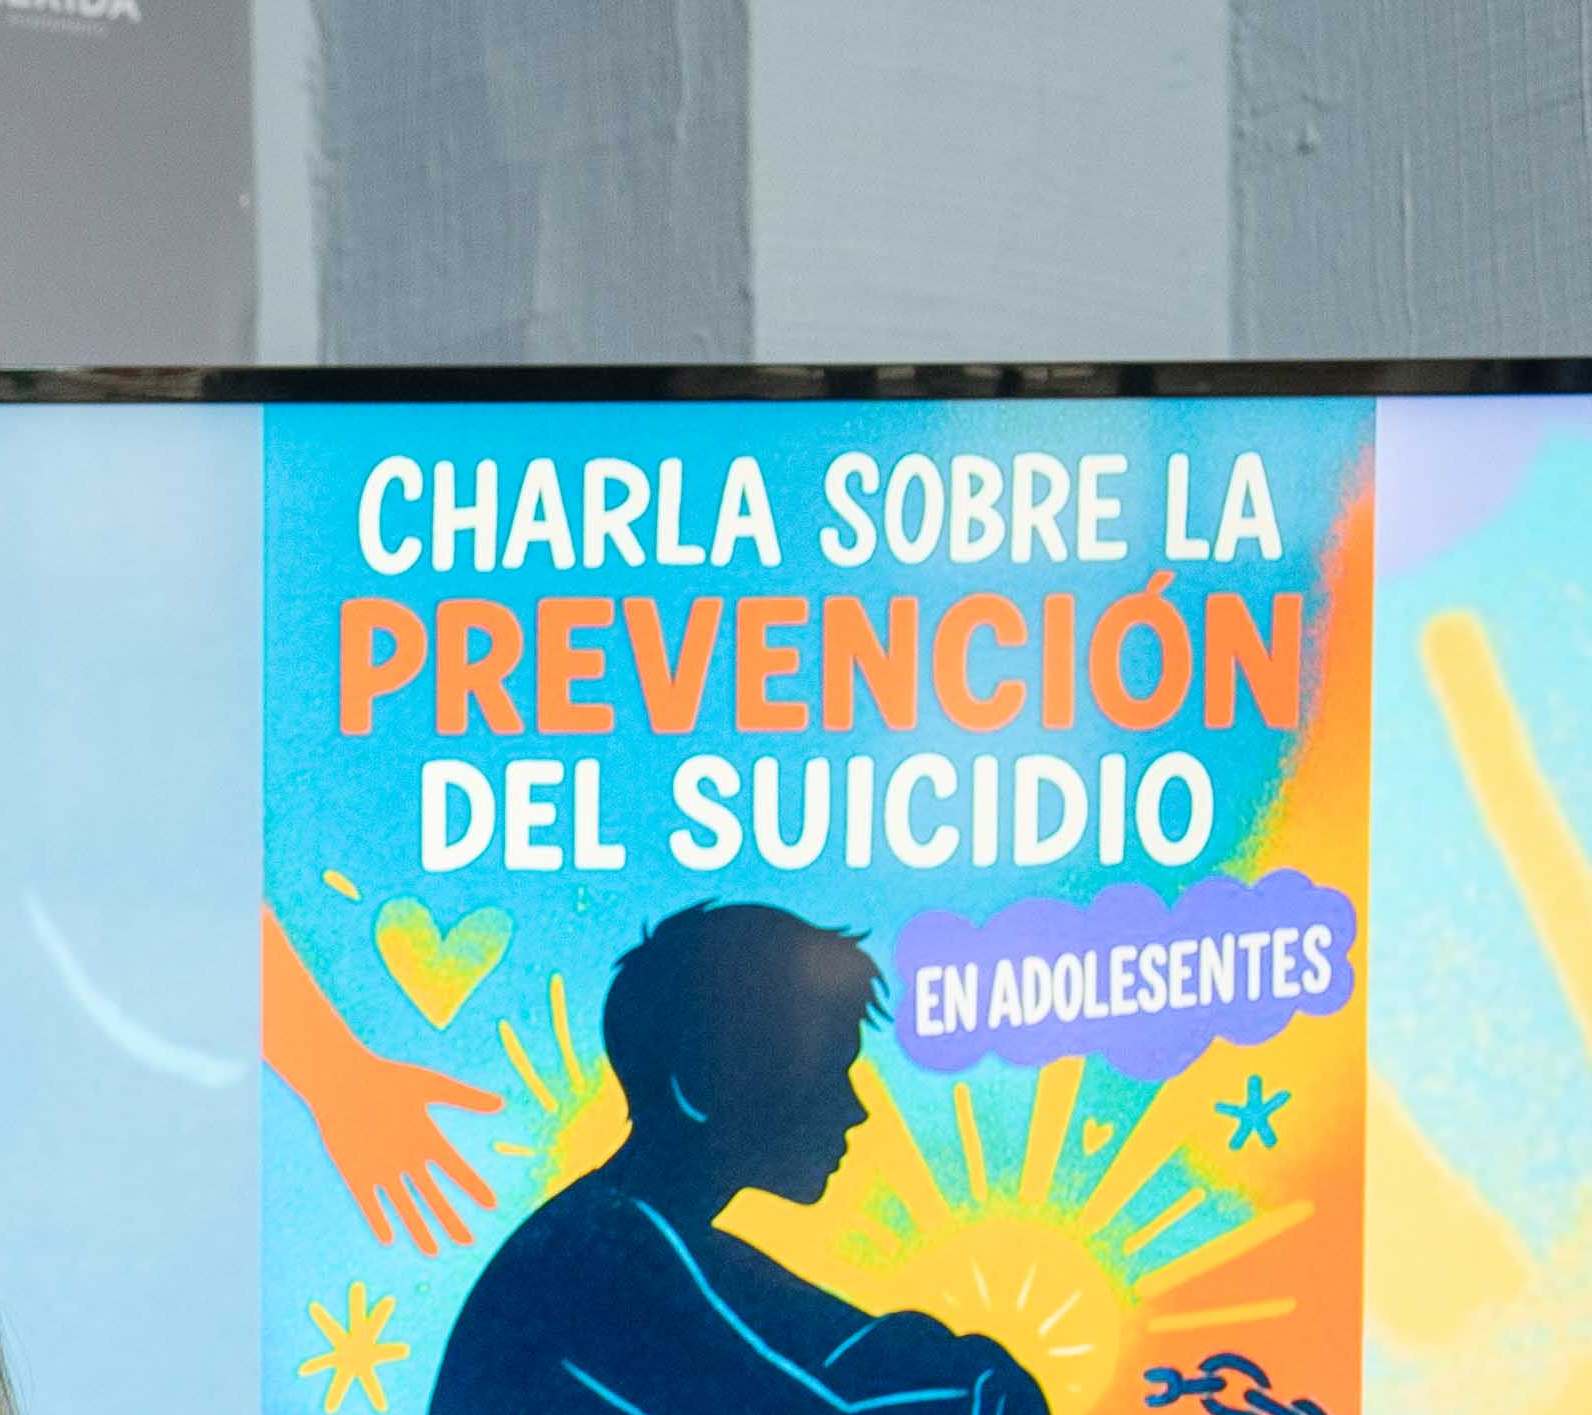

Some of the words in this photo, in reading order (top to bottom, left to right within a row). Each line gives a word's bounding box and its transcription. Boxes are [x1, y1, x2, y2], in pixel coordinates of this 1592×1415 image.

[359, 456, 781, 574] CHARLA
[820, 453, 1127, 566] SOBRE
[1165, 453, 1282, 561] LA
[339, 573, 1304, 735] PREVENCIÓN
[421, 757, 627, 872] DEL
[669, 751, 1212, 869] SUICIDIO
[916, 966, 976, 1036] EN
[989, 925, 1333, 1029] ADOLESENTES
